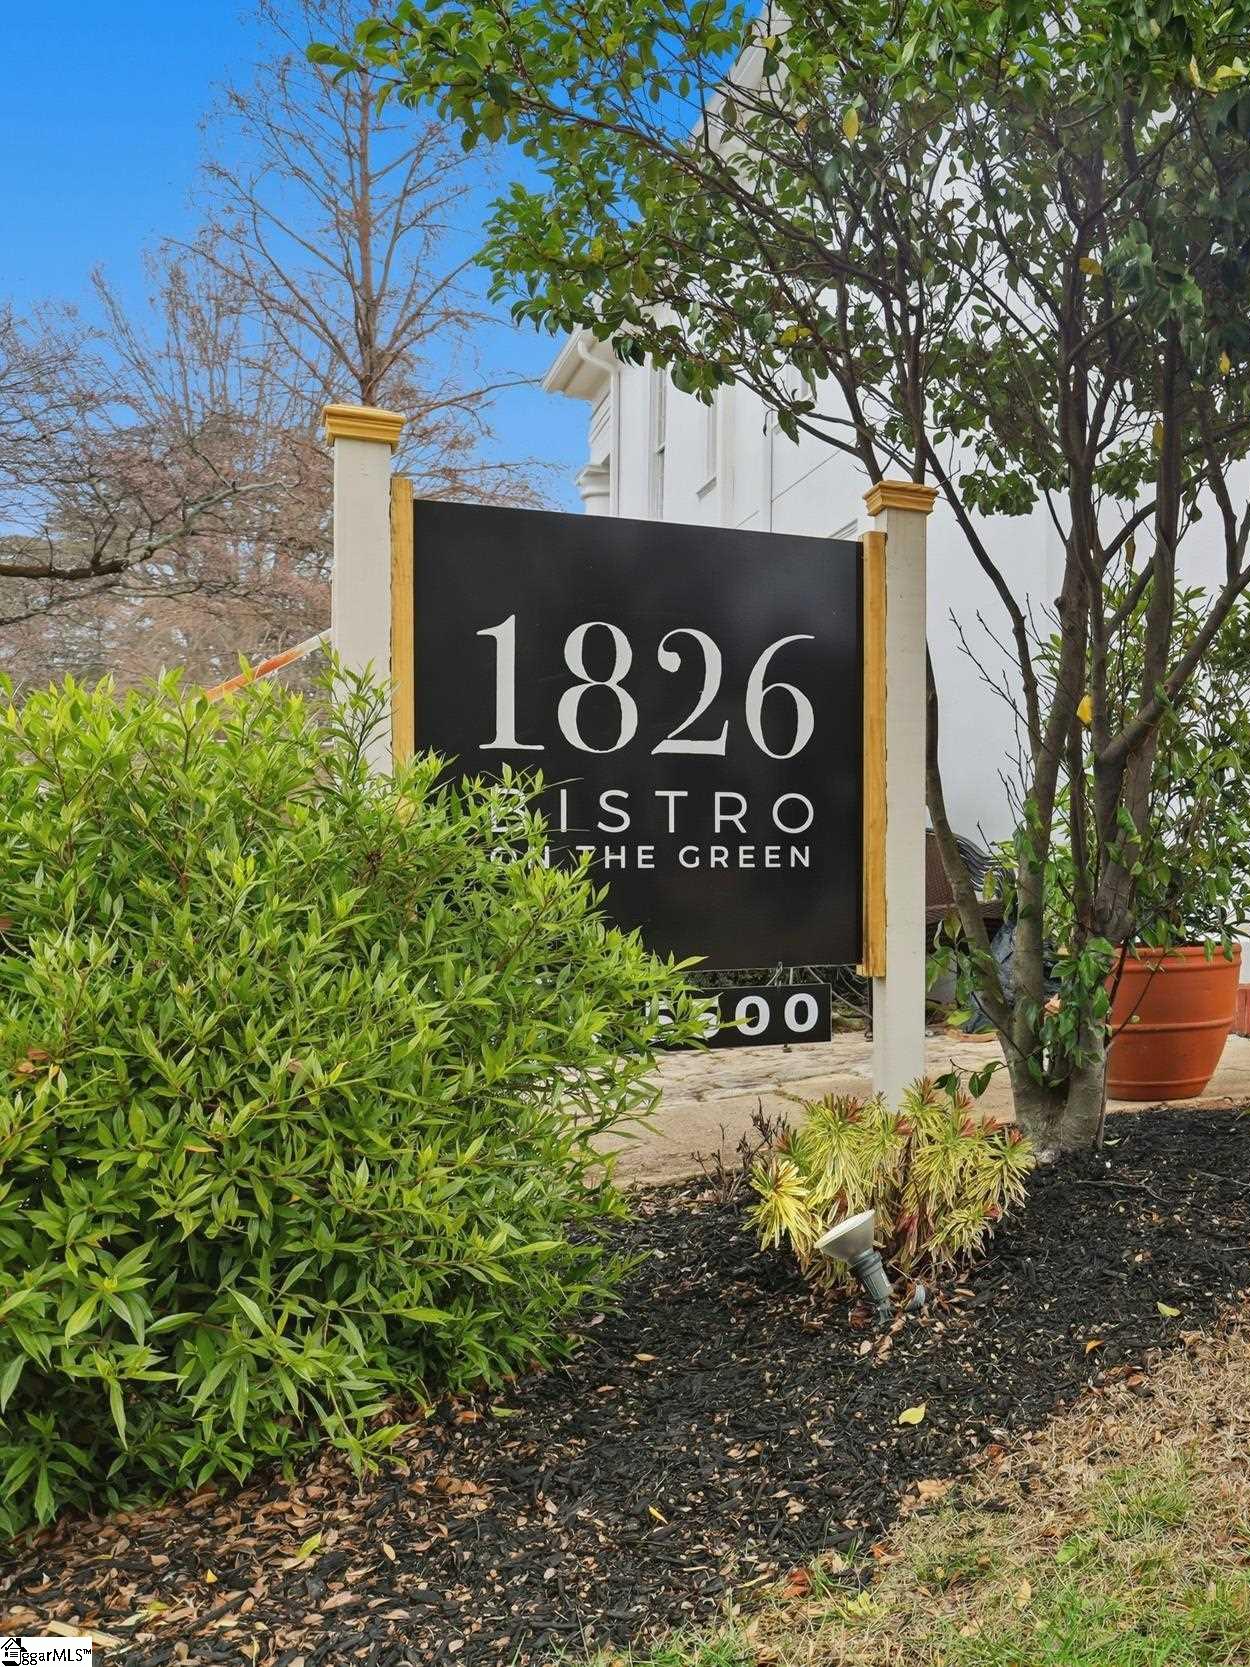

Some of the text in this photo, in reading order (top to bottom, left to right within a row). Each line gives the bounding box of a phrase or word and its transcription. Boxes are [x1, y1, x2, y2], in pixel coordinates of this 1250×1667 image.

[476, 614, 816, 760] 1826
[490, 788, 814, 834] BISTRO
[679, 845, 811, 868] GREEN
